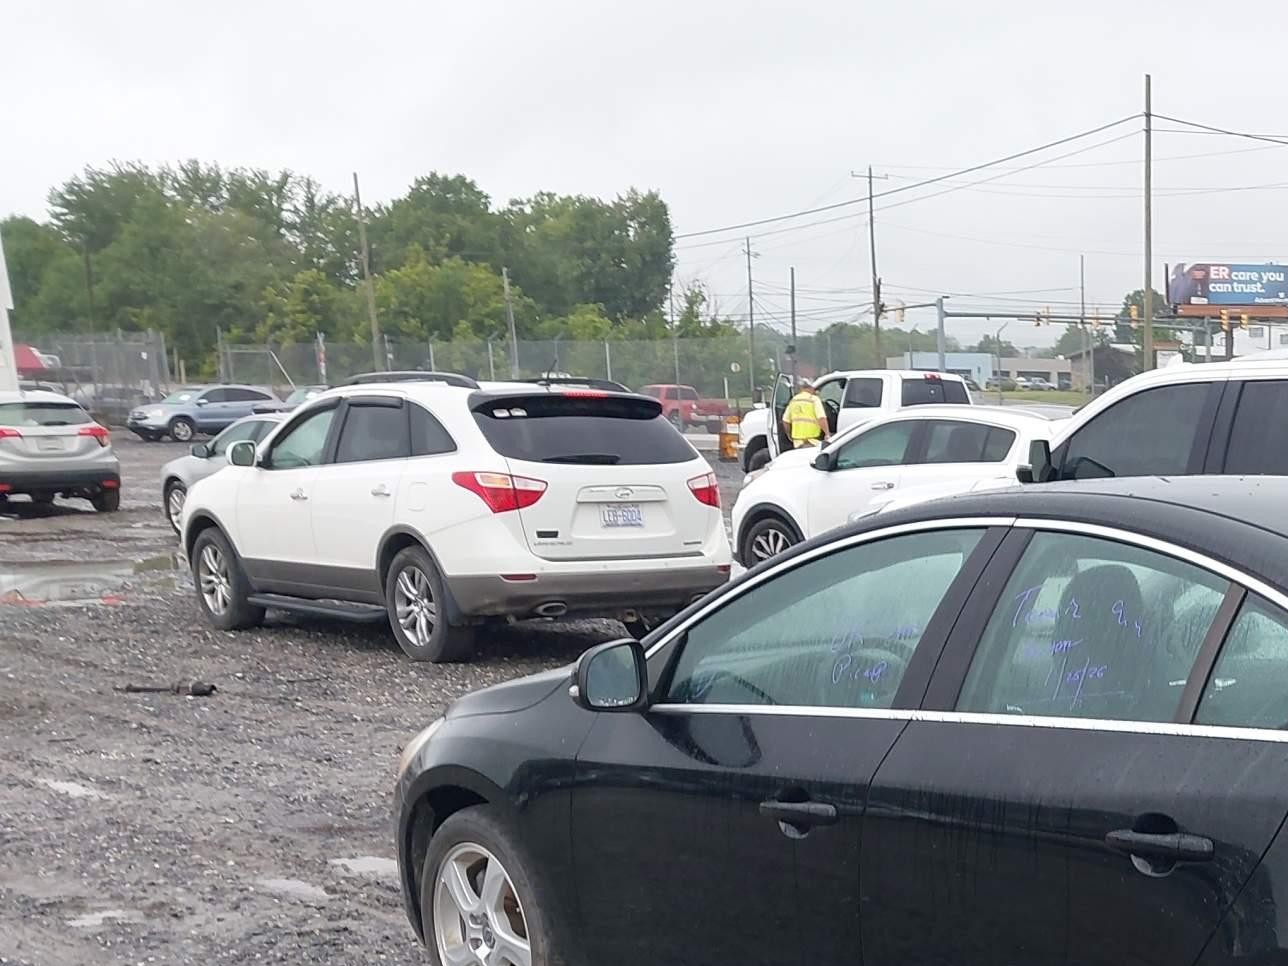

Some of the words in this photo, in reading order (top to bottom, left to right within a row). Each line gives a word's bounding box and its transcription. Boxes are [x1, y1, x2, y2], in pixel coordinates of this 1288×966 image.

[1209, 266, 1230, 279] ER
[1231, 271, 1259, 281] care
[1260, 271, 1285, 283] you
[1208, 282, 1232, 292] can
[1233, 281, 1265, 293] trust.
